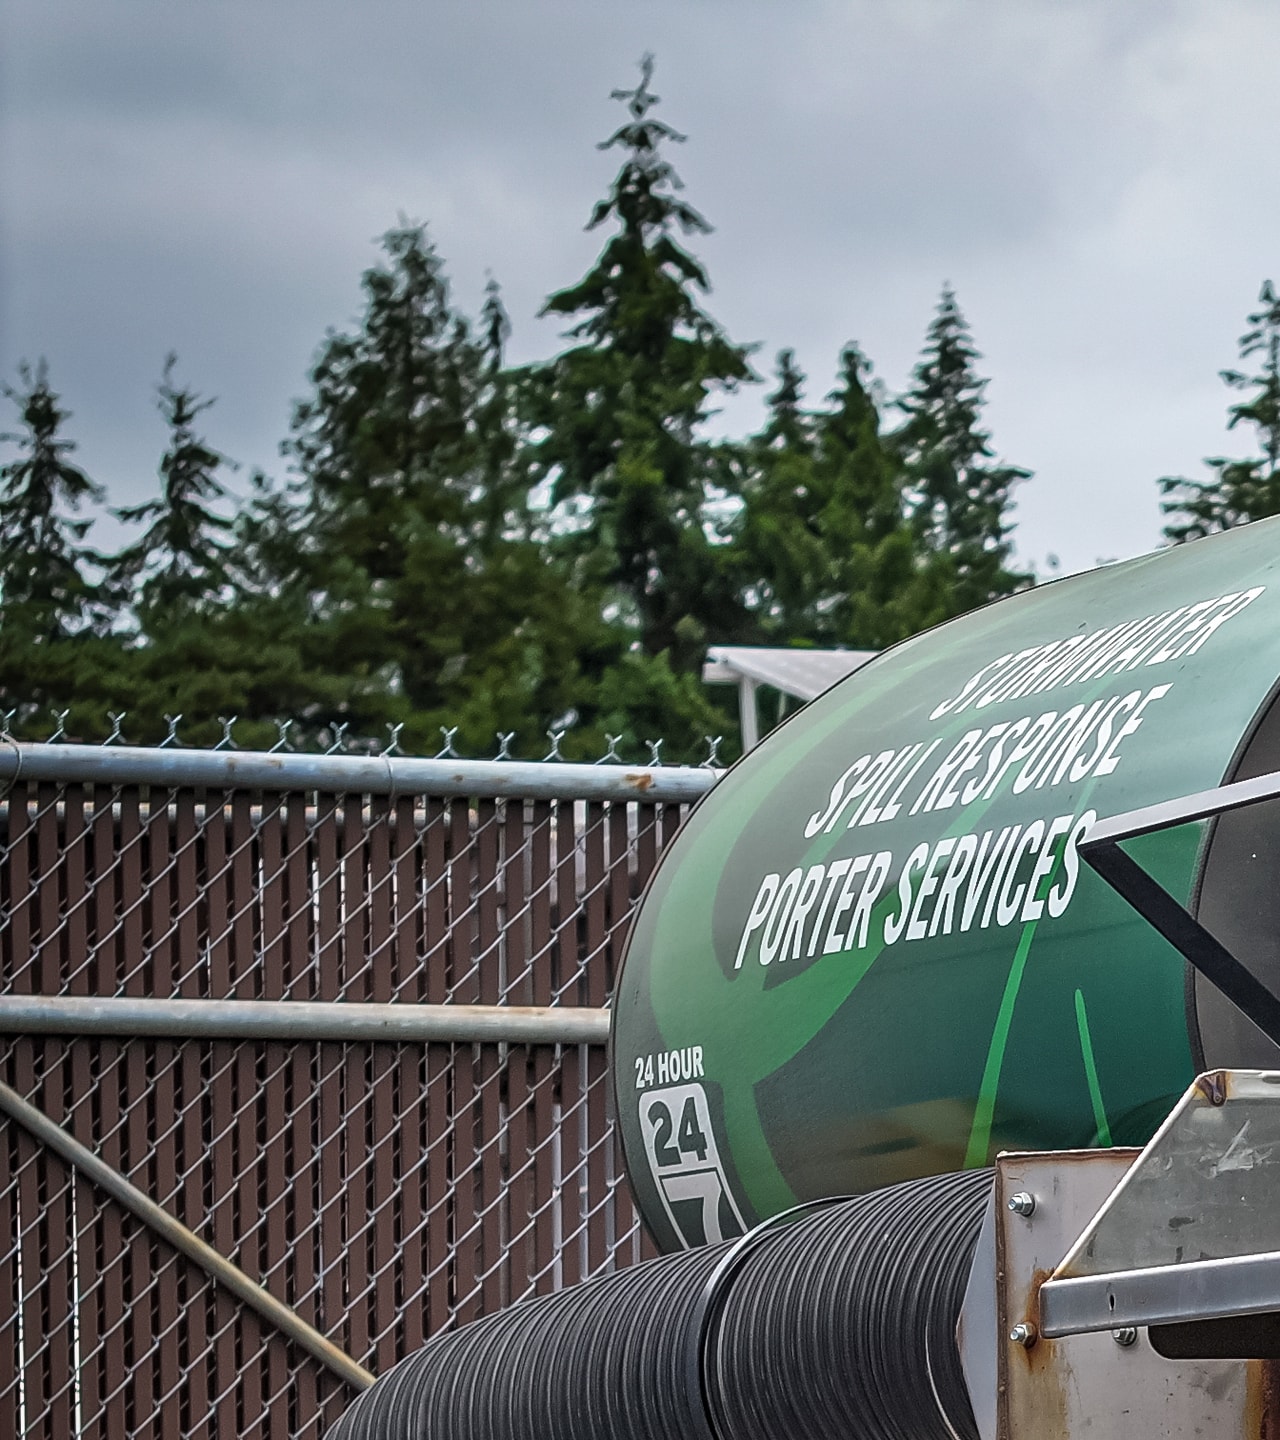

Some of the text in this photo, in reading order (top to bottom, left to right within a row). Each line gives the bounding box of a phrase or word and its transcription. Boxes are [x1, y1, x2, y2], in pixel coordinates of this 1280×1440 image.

[929, 585, 1267, 721] STORMWATER
[803, 682, 1174, 838] SPILL RESPONSE
[734, 809, 1097, 970] PORTER SERVICES
[634, 1045, 705, 1089] 24 HOUR
[647, 1096, 709, 1168] 24
